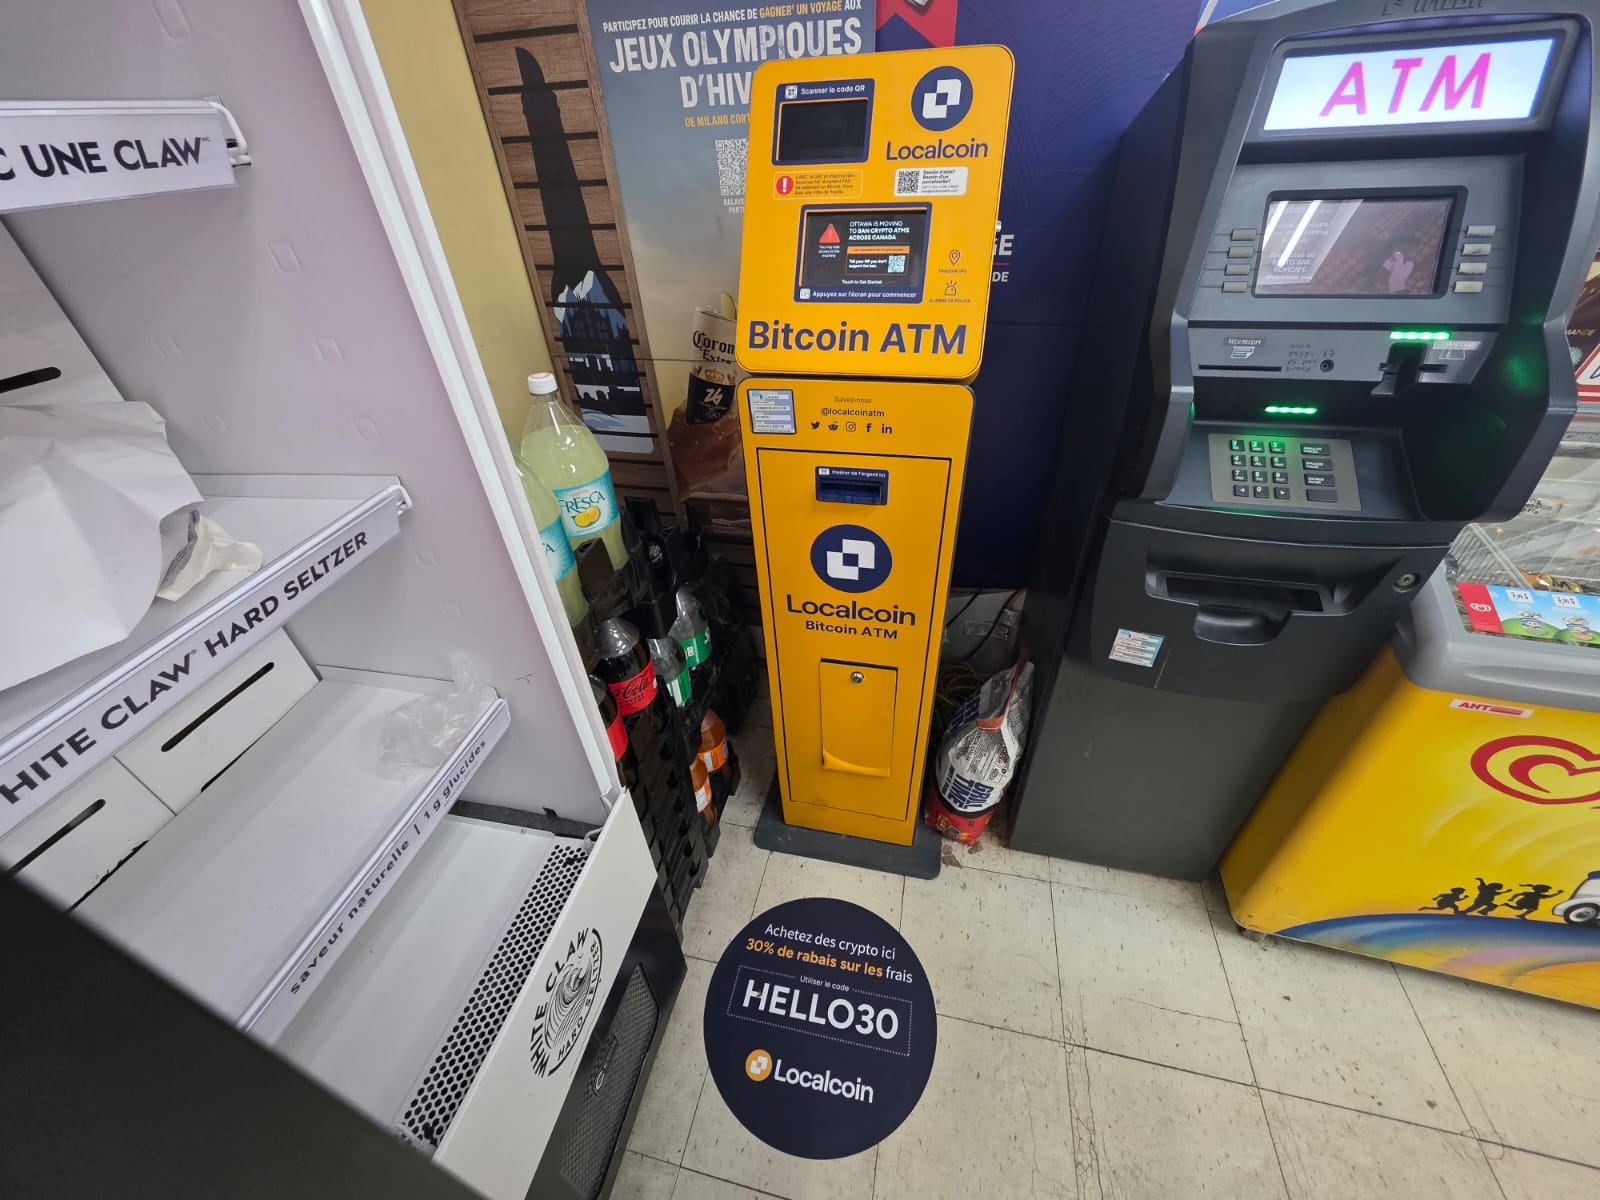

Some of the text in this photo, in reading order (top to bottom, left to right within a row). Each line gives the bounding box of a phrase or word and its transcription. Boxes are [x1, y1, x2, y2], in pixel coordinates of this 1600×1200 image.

[602, 18, 648, 33] PARTICIPEZ
[647, 16, 669, 29] POUR
[670, 13, 699, 27] COURIR
[699, 12, 712, 24] LA
[713, 10, 746, 23] CHANCE
[747, 8, 758, 20] DE
[796, 4, 809, 15] UN
[810, 0, 842, 13] VOYAGE
[843, 0, 862, 10] AUX
[609, 17, 863, 73] JEUX OLYMPIQUES
[800, 84, 866, 97] Scanner le code QR
[1318, 52, 1492, 117] ATM
[684, 116, 696, 128] DE
[697, 114, 729, 127] MILANO
[20, 141, 109, 177] UNE
[885, 138, 989, 161] Localcoin
[992, 271, 1010, 282] DE
[812, 291, 837, 299] Appuyez
[748, 319, 968, 355] Bitcoin ATM
[703, 349, 732, 365] Extra
[821, 407, 885, 418] @localcoinatm
[833, 395, 872, 404] Suivez-nous
[558, 491, 606, 513] FRESCA
[204, 596, 280, 658] HARD
[283, 531, 369, 600] SELTZER
[786, 594, 917, 626] Localcoin
[805, 620, 898, 640] Bitcoin ATM
[1458, 702, 1490, 711] AHT
[290, 922, 346, 995] saveur
[347, 839, 410, 920] naturelle
[442, 741, 486, 799] glucides
[765, 923, 897, 960] Achetez des crypto ici
[745, 938, 914, 984] 30% de rabais sur les frais
[800, 974, 850, 992] Utiliser le code
[530, 927, 589, 1079] WHITE CLAW
[742, 979, 899, 1039] HELLO30
[557, 1016, 583, 1062] HARD
[773, 1059, 874, 1104] Localcoin
